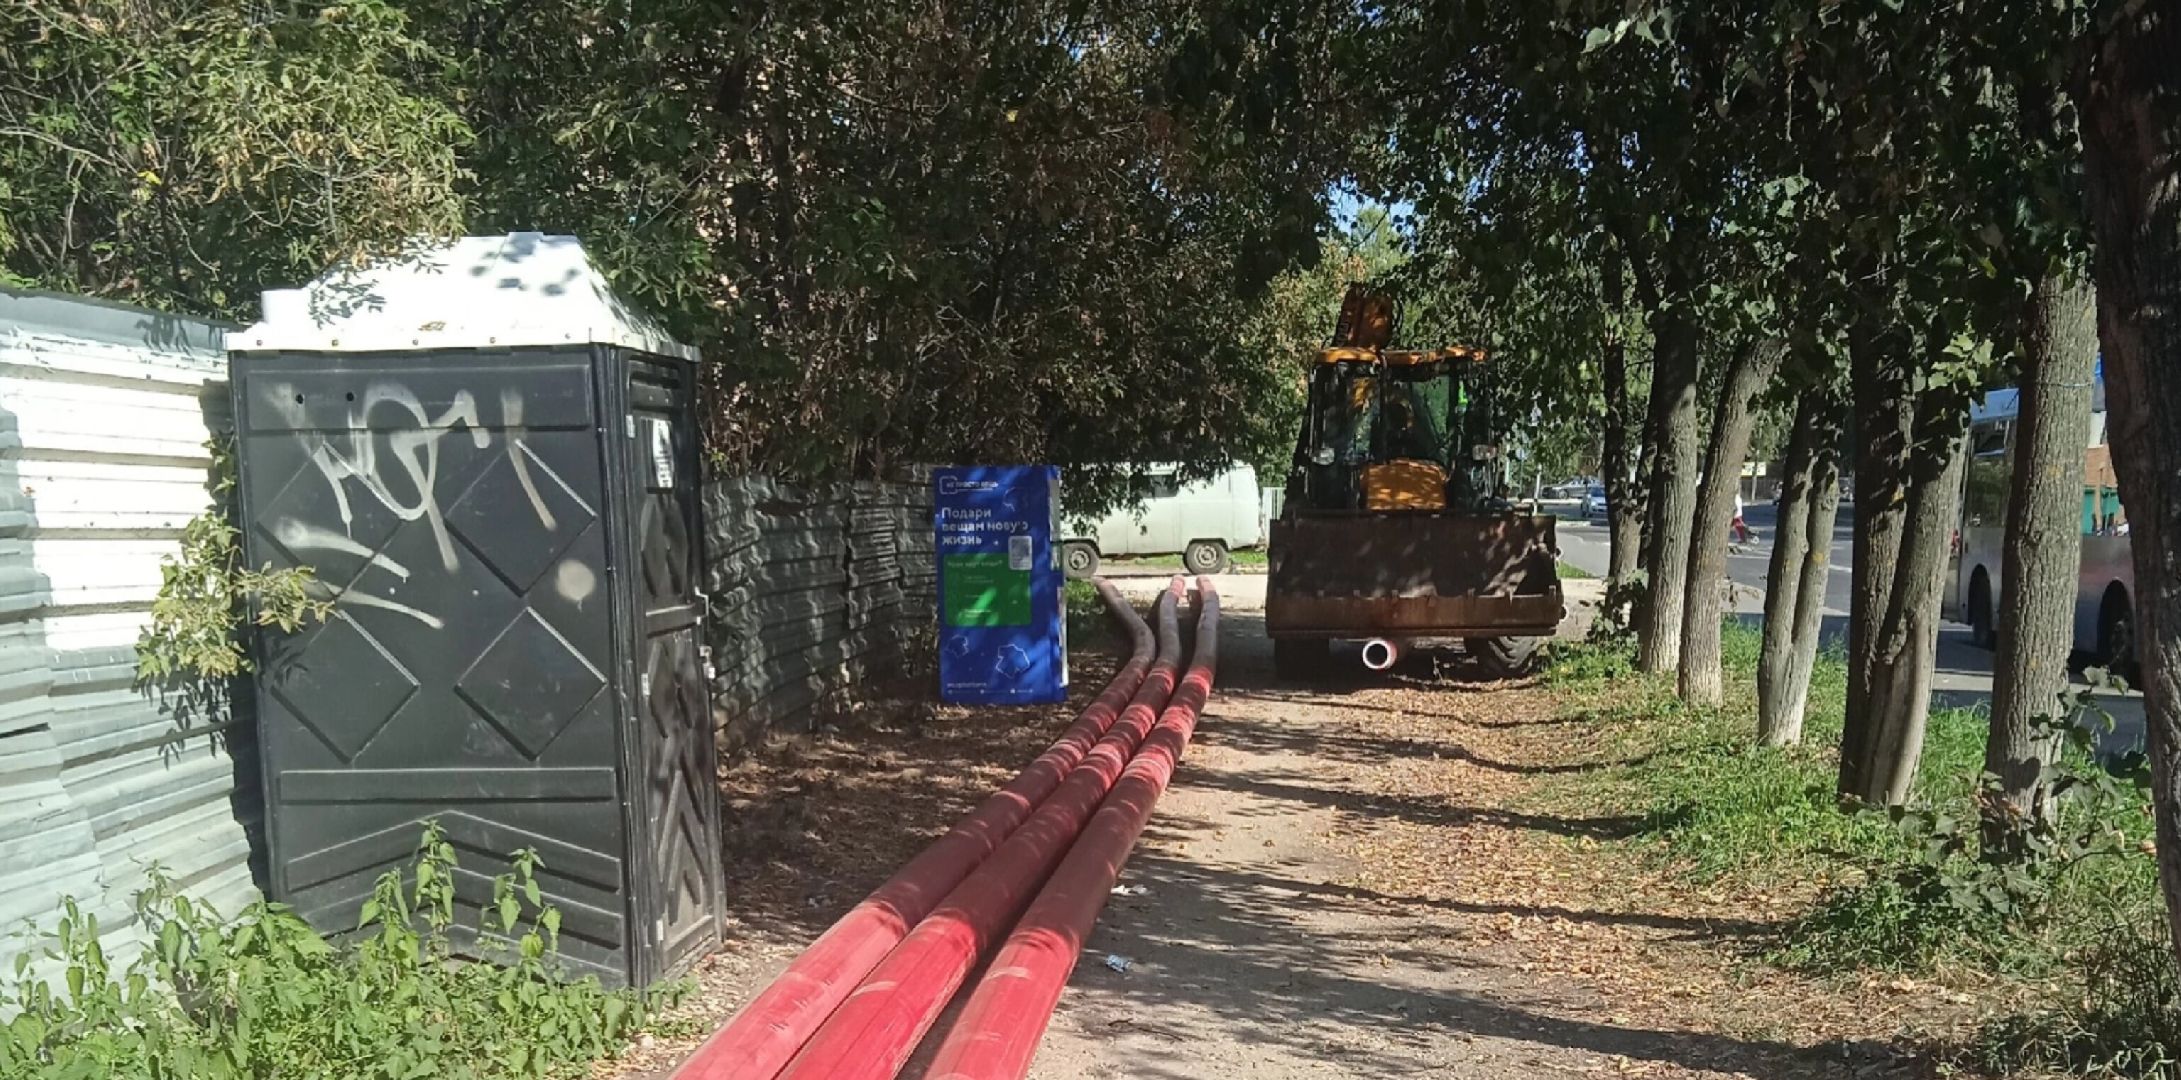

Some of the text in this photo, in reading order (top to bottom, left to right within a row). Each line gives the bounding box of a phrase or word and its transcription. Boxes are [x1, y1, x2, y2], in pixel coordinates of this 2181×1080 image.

[942, 507, 992, 520] Подари
[942, 522, 984, 533] вещам
[942, 535, 982, 545] жизнь
